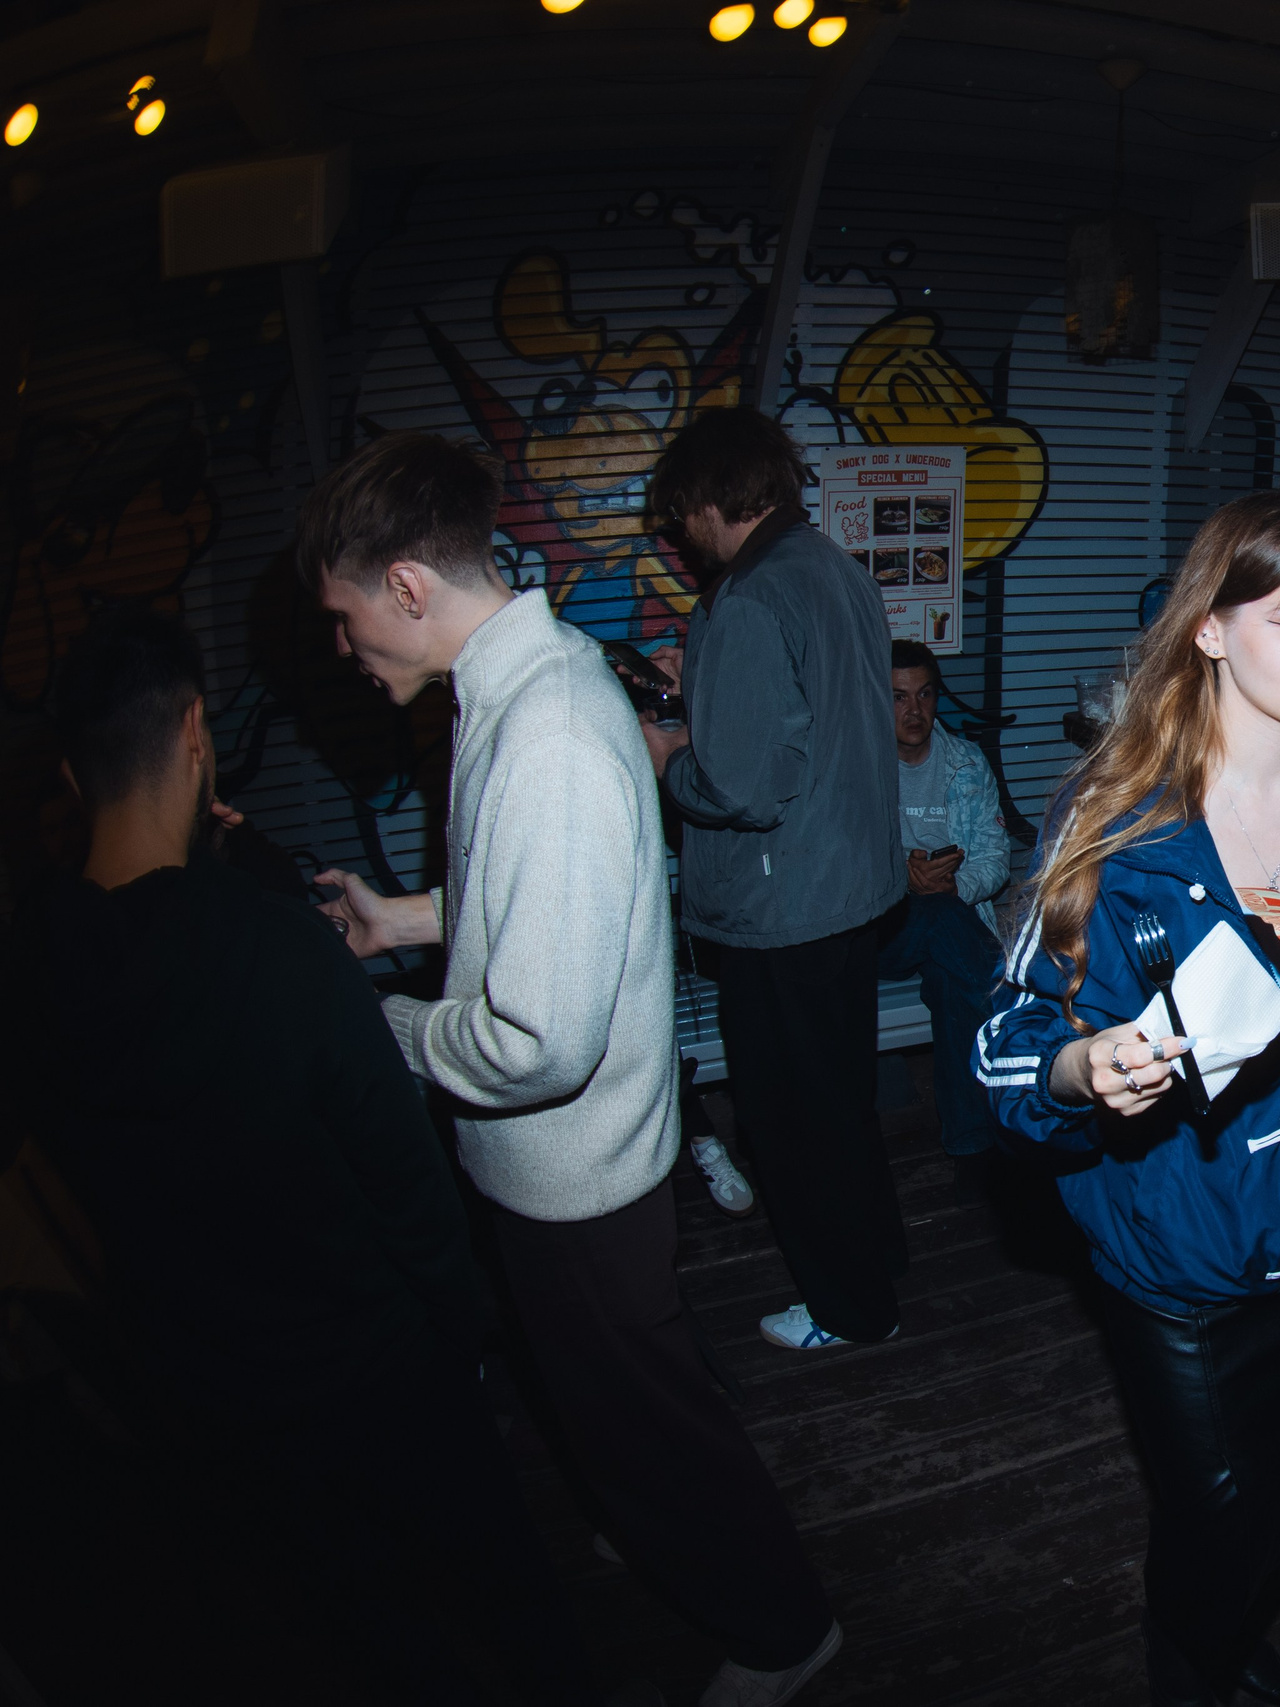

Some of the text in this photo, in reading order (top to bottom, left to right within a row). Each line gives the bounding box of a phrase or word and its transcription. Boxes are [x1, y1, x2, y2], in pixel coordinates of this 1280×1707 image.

[836, 454, 951, 470] SMOKY DOG X UNDERDOG
[860, 473, 926, 484] SPECIAL MENU
[834, 496, 867, 513] Food
[884, 604, 907, 614] inks
[906, 806, 926, 817] my
